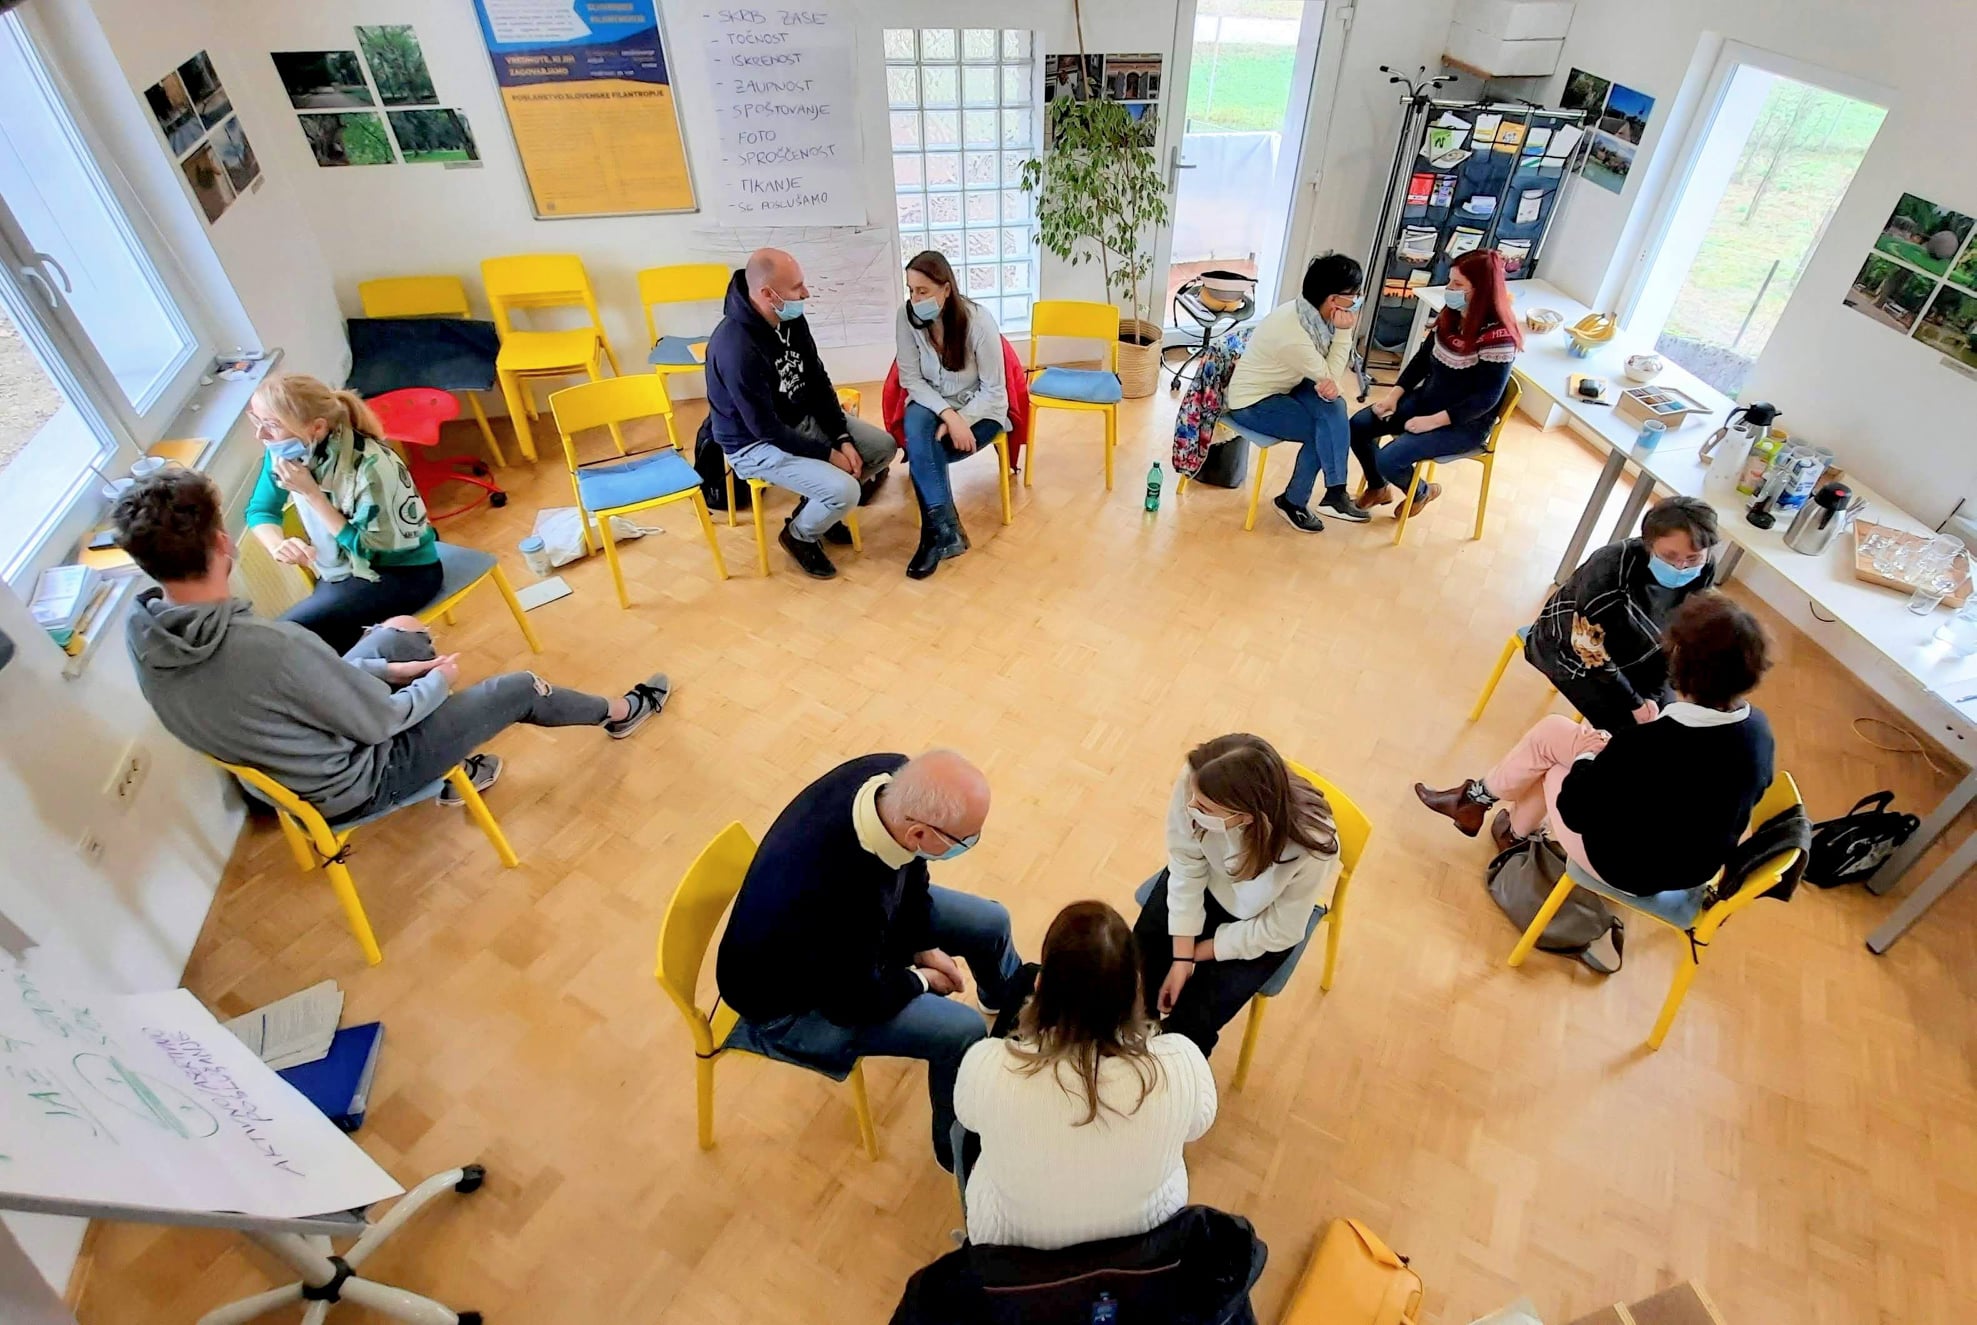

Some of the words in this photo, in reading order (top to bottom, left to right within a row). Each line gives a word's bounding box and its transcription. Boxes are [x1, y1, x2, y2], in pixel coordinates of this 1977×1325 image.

[718, 9, 766, 24] SKRB
[778, 10, 829, 25] ZASE
[727, 31, 789, 45] TOČNOST
[731, 53, 803, 67] ISKRENOST
[734, 79, 814, 94] ZAUPNOST
[612, 90, 664, 99] FILANTROPIJE
[732, 101, 831, 121] SPOŠTOVANJE
[738, 130, 776, 145] FOTO
[738, 144, 836, 167] SPROŠČENOST
[740, 176, 804, 193] TIKANJE
